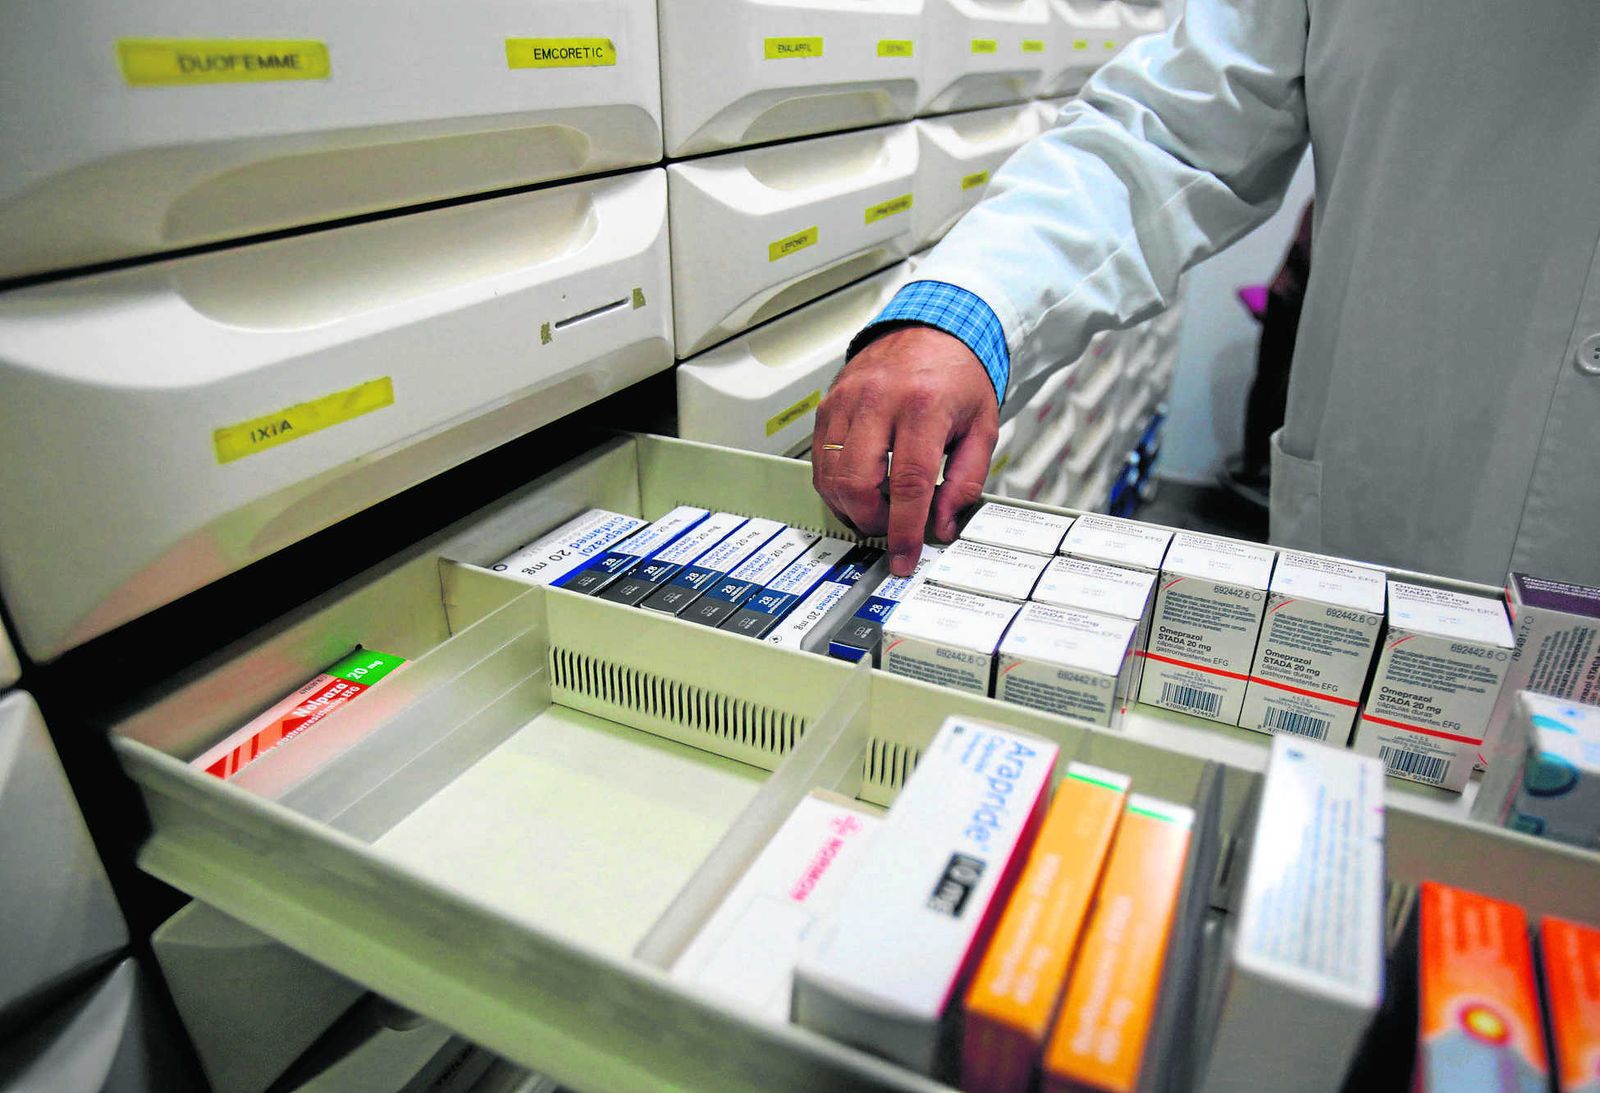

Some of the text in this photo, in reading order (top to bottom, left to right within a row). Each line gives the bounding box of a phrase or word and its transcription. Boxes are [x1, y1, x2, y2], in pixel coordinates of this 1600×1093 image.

[533, 47, 603, 60] EMCORETIC
[177, 54, 302, 74] DUOFEMME
[250, 419, 293, 443] IXIA
[578, 519, 639, 557] omeprazol
[521, 516, 625, 576] cinfamed 20 mg
[643, 565, 658, 574] 28
[685, 572, 699, 581] 28
[722, 584, 736, 593] 28
[758, 595, 773, 605] 28
[869, 604, 884, 614] 28
[1326, 608, 1365, 623] 692442.6
[1159, 626, 1203, 641] Omeprazol
[1158, 633, 1212, 652] STADA 20 mg
[1213, 657, 1229, 667] EFG
[1265, 648, 1312, 665] Omeprazol
[1263, 656, 1321, 676] STADA 20 mg
[293, 681, 349, 718] Nolpaza
[347, 667, 369, 681] 20
[368, 659, 384, 670] mg
[342, 685, 360, 699] EFG
[1321, 682, 1338, 692] EFG
[1381, 686, 1433, 703] Omeprazol
[1379, 694, 1442, 715] STADA 20 mg
[1442, 720, 1461, 730] EFG
[964, 741, 1036, 843] Arapride
